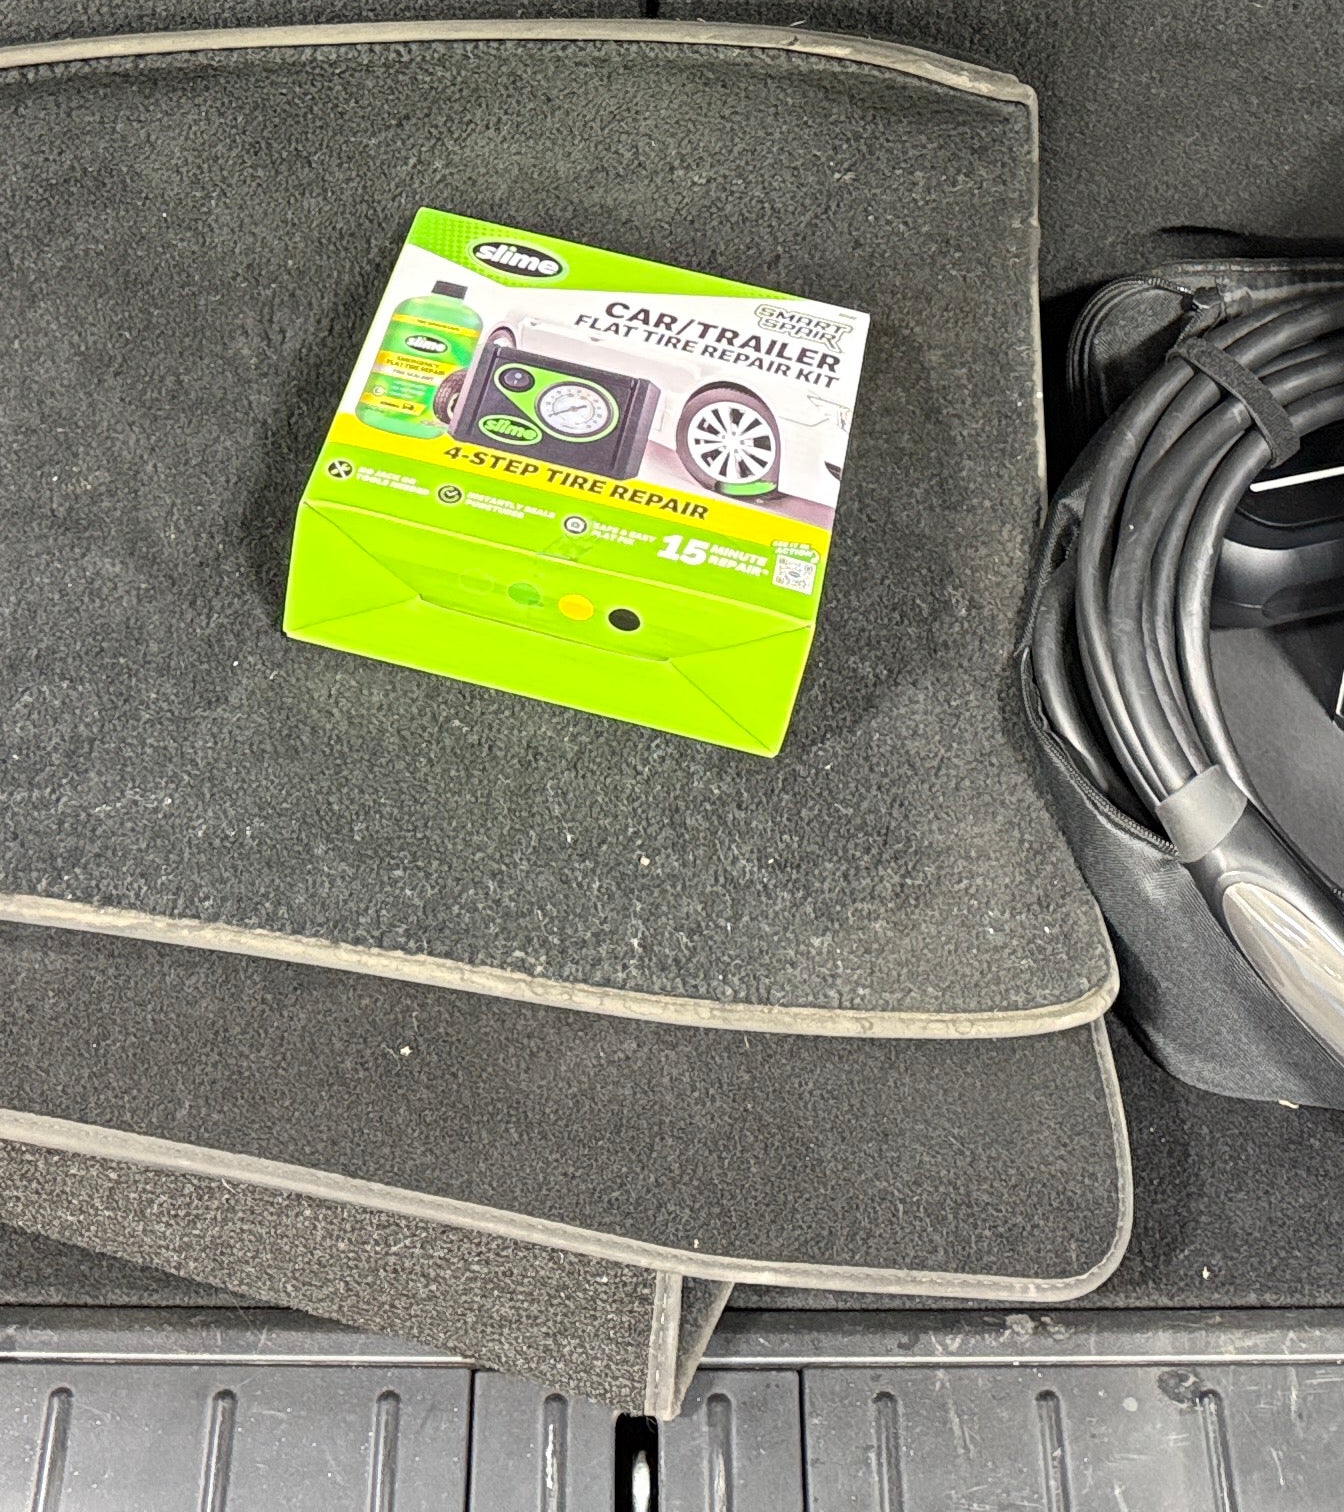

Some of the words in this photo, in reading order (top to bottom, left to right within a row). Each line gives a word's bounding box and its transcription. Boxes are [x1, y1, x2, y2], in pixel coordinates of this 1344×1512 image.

[476, 245, 559, 274] slime
[758, 307, 844, 334] SMART
[762, 318, 840, 351] SPAIR
[574, 314, 638, 337] FLAT
[643, 329, 708, 353] TIRE
[700, 344, 791, 377] REPAIR
[795, 368, 840, 389] KIT
[605, 302, 840, 373] CAR/TRAILER
[484, 419, 537, 440] slime
[444, 446, 539, 478] 4-STEP
[546, 468, 607, 495] TIRE
[610, 482, 710, 520] REPAIR
[656, 534, 710, 566] 15
[710, 544, 768, 567] MINUTE
